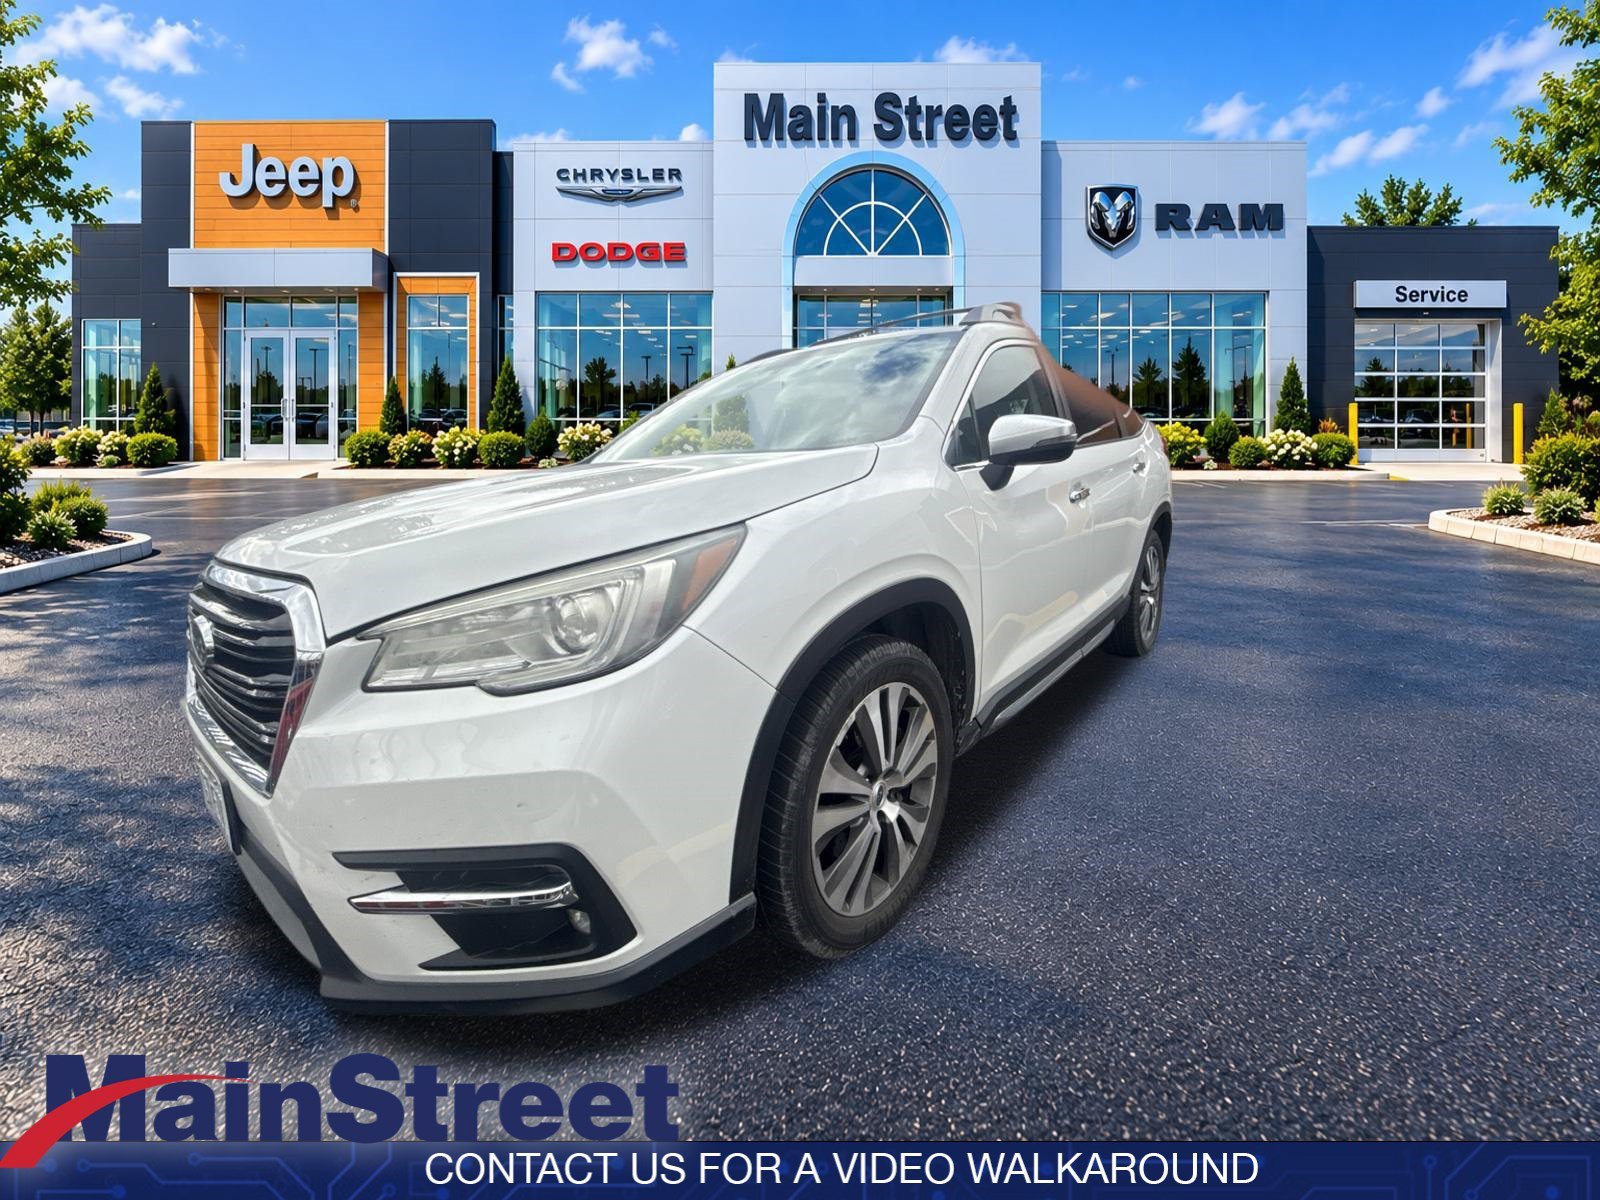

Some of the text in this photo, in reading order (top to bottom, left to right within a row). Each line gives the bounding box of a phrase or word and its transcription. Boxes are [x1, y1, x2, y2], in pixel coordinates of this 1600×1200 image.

[744, 91, 1018, 141] Main Street
[218, 143, 355, 208] Jeep
[556, 168, 683, 182] CHRYSLER
[1154, 203, 1284, 231] RAM
[551, 242, 687, 262] DODGE
[1394, 285, 1469, 304] Service
